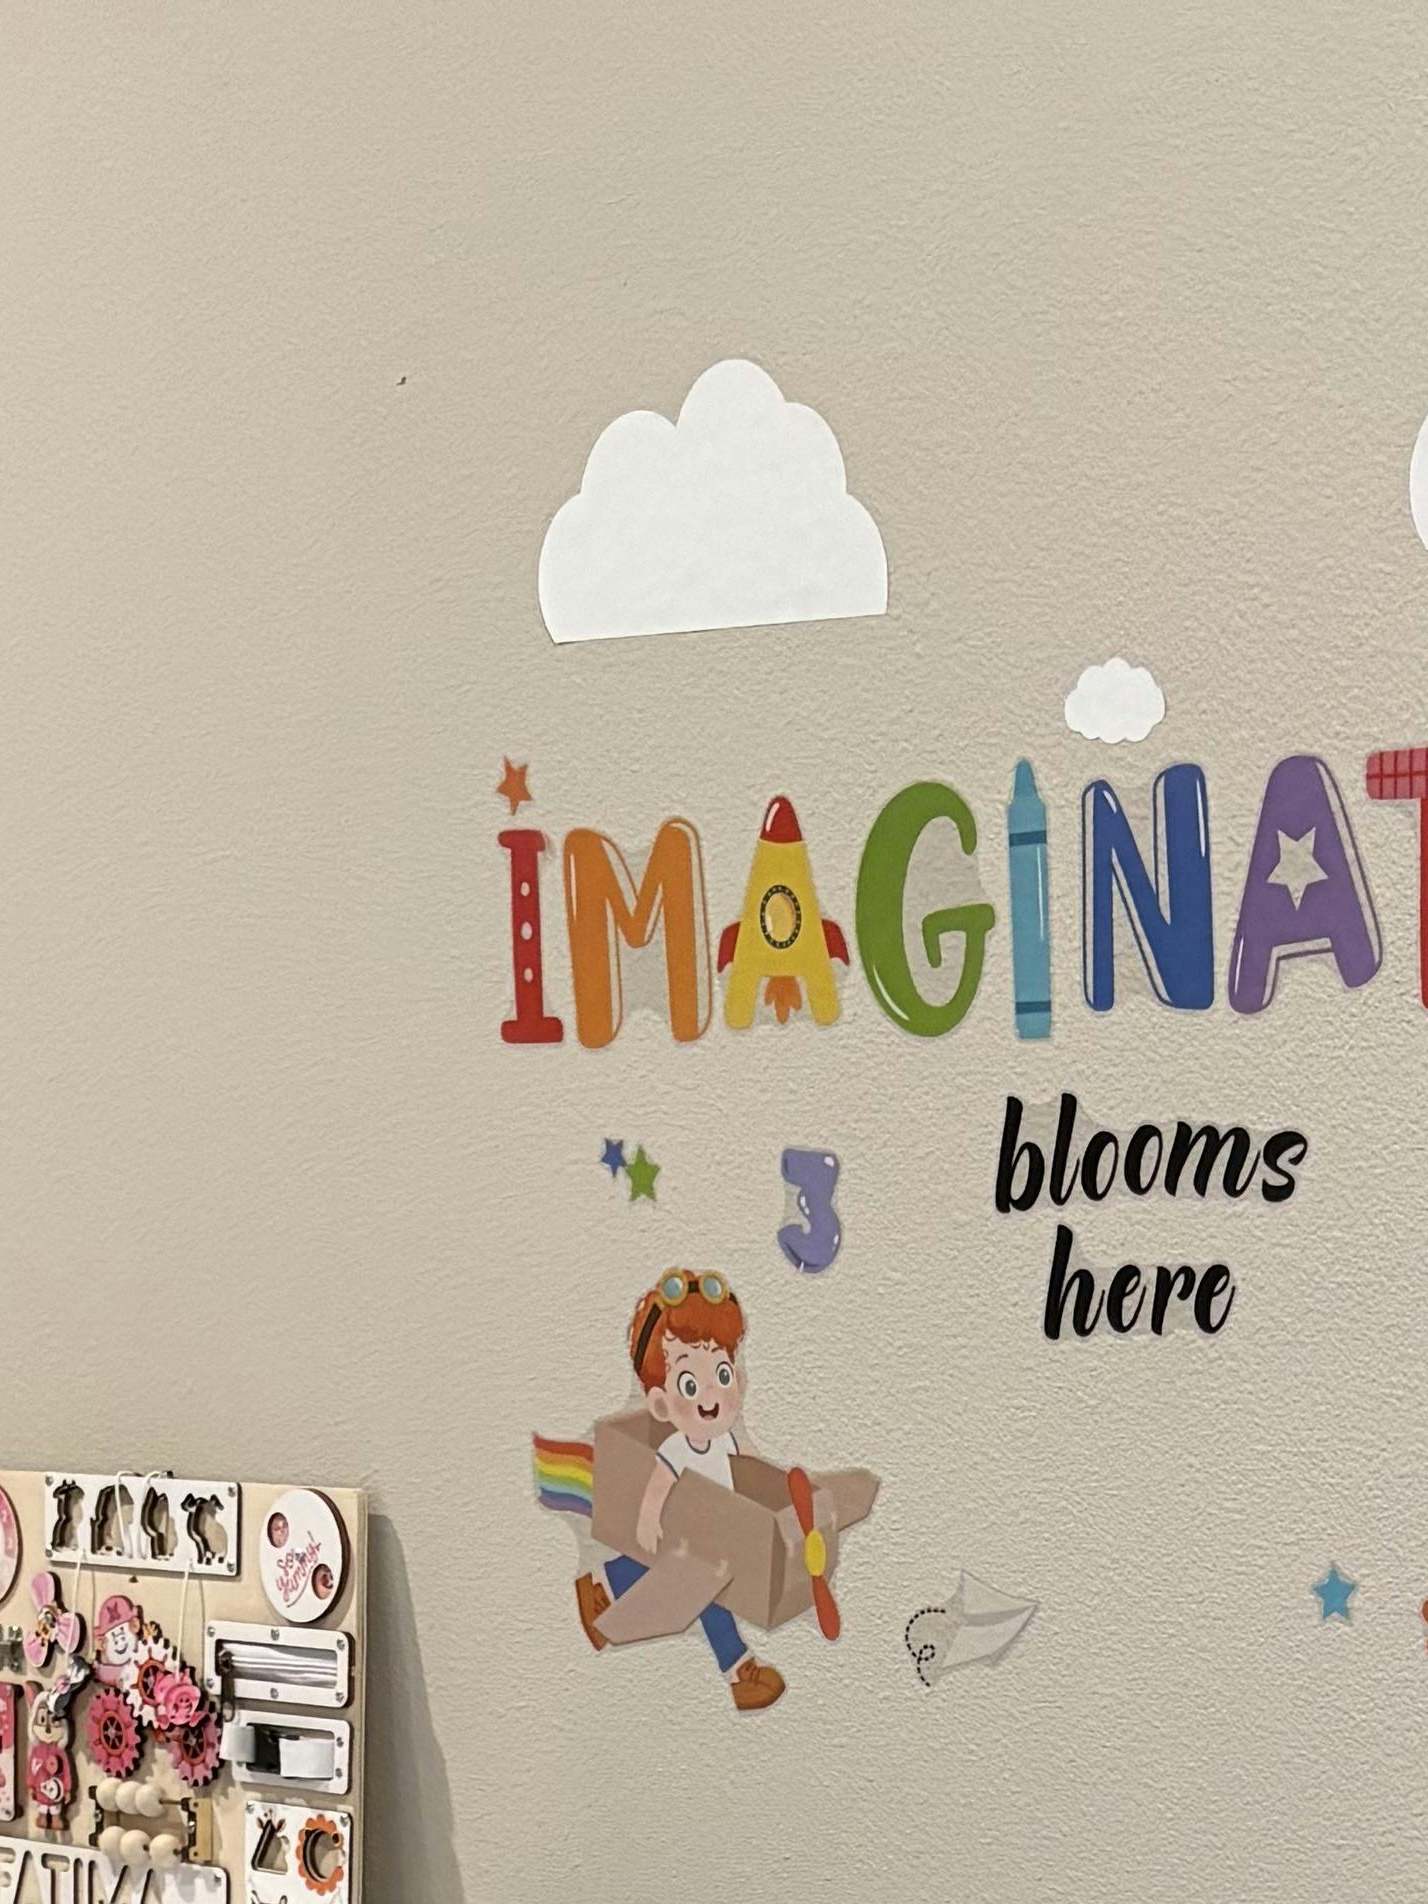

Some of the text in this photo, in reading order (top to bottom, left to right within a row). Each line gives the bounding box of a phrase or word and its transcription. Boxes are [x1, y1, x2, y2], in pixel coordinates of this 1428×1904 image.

[777, 1148, 842, 1274] 3
[993, 1090, 1310, 1215] blooms
[1043, 1224, 1237, 1341] here
